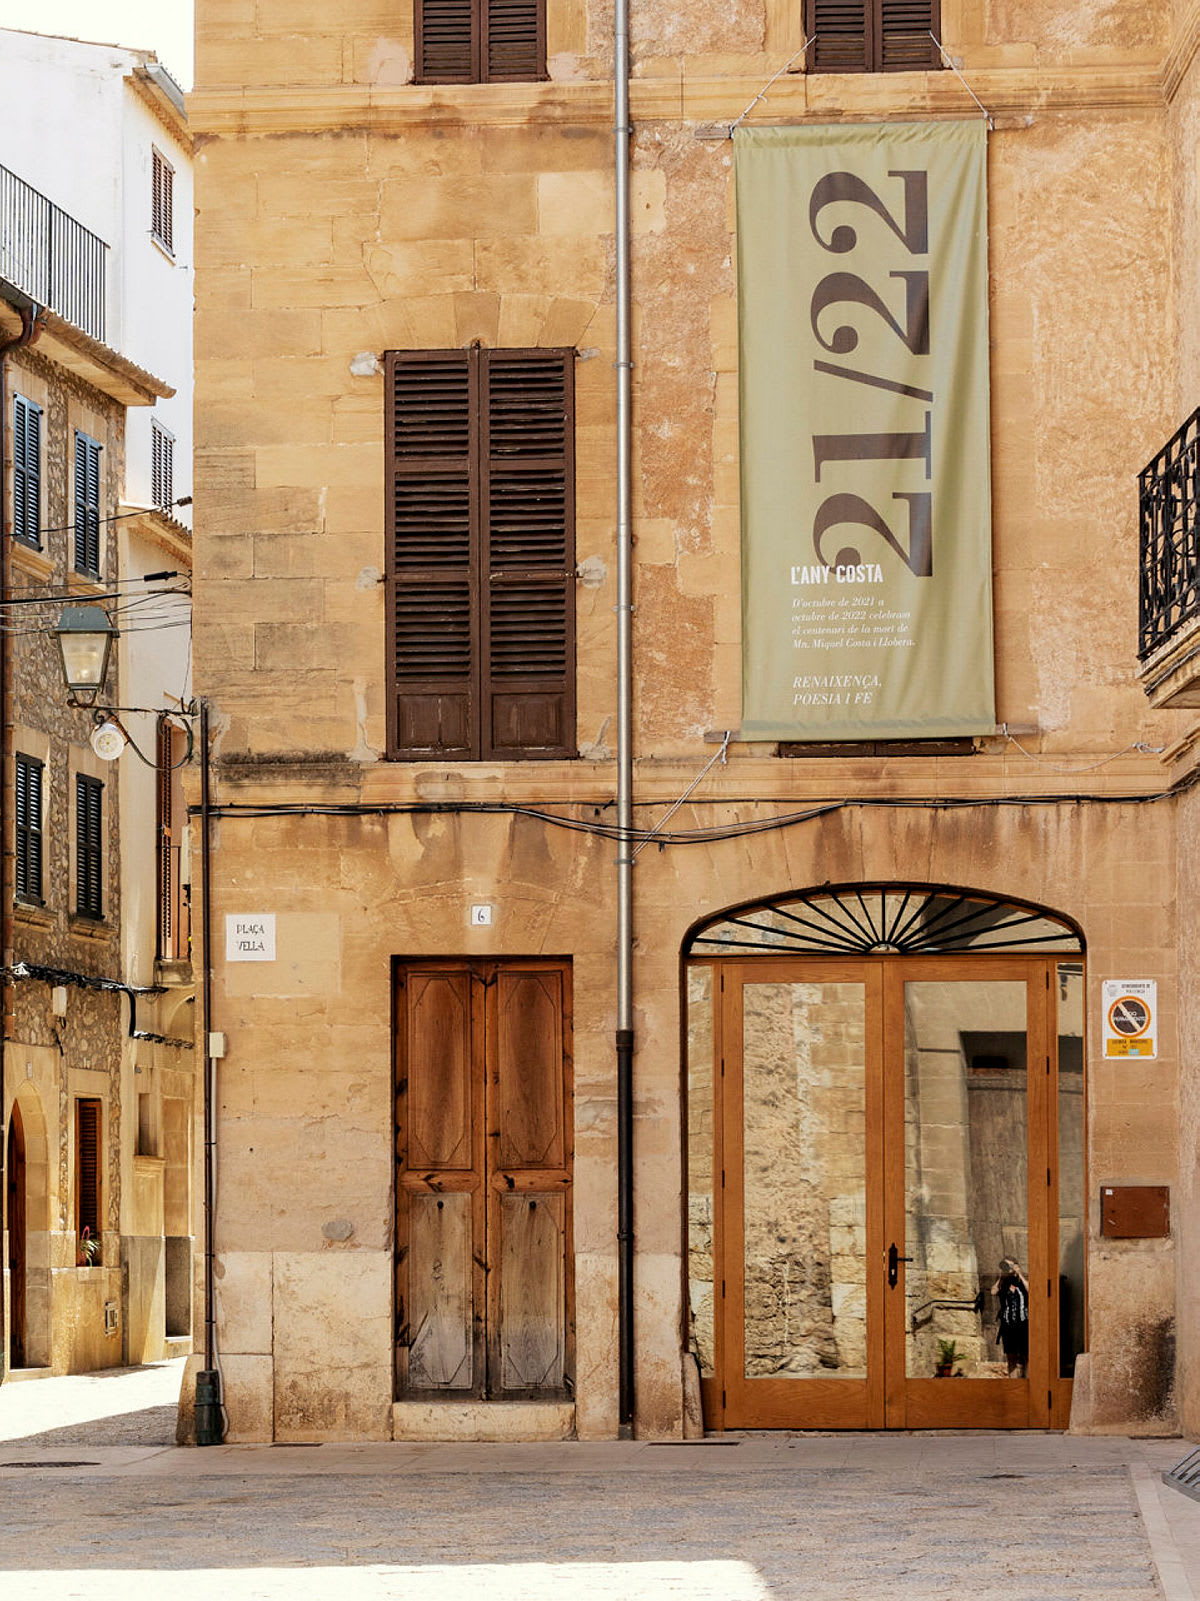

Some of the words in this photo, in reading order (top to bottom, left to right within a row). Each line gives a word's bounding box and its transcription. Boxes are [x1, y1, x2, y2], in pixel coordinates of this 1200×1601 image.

[808, 169, 934, 578] 21/22
[790, 564, 830, 585] L'ANY
[836, 563, 884, 583] COSTA
[792, 597, 836, 609] D'octubre
[838, 596, 849, 607] de
[851, 596, 875, 607] 2021
[878, 598, 885, 607] a
[791, 611, 826, 622] octubre
[828, 609, 840, 621] de
[841, 610, 867, 620] 2022
[791, 625, 801, 636] el
[803, 625, 846, 635] centenari
[848, 624, 859, 635] de
[861, 624, 871, 634] la
[873, 623, 895, 633] mort
[897, 622, 909, 633] de
[793, 638, 811, 649] Mn.
[812, 638, 844, 651] Miquel
[846, 637, 872, 648] Costa
[792, 674, 883, 690] RENAIXENÇA,
[792, 692, 842, 706] POESIA
[844, 692, 851, 706] I
[854, 692, 874, 705] FE
[477, 907, 486, 923] 6
[235, 923, 266, 936] PLAÇA
